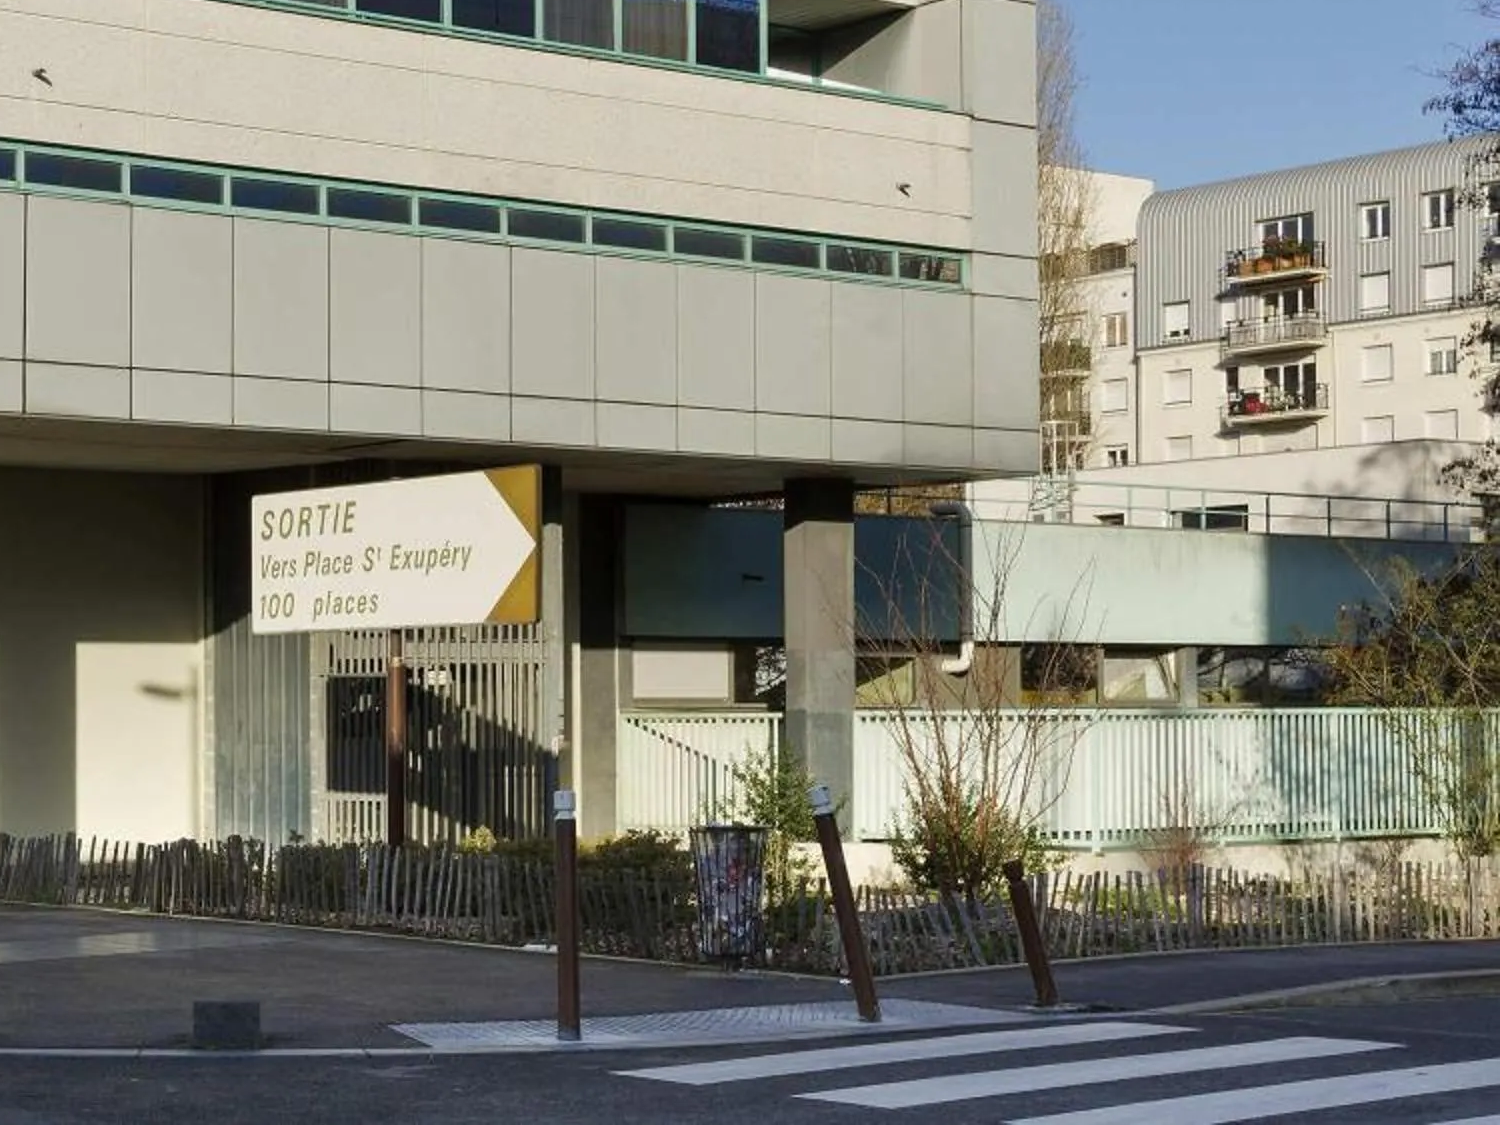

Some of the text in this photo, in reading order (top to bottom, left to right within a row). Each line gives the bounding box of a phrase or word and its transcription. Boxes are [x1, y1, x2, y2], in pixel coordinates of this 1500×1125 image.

[261, 501, 357, 541] SORTIE
[260, 554, 297, 579] Vers
[303, 551, 353, 578] Place
[390, 540, 472, 575] Exupéry
[260, 591, 379, 621] 100 places
